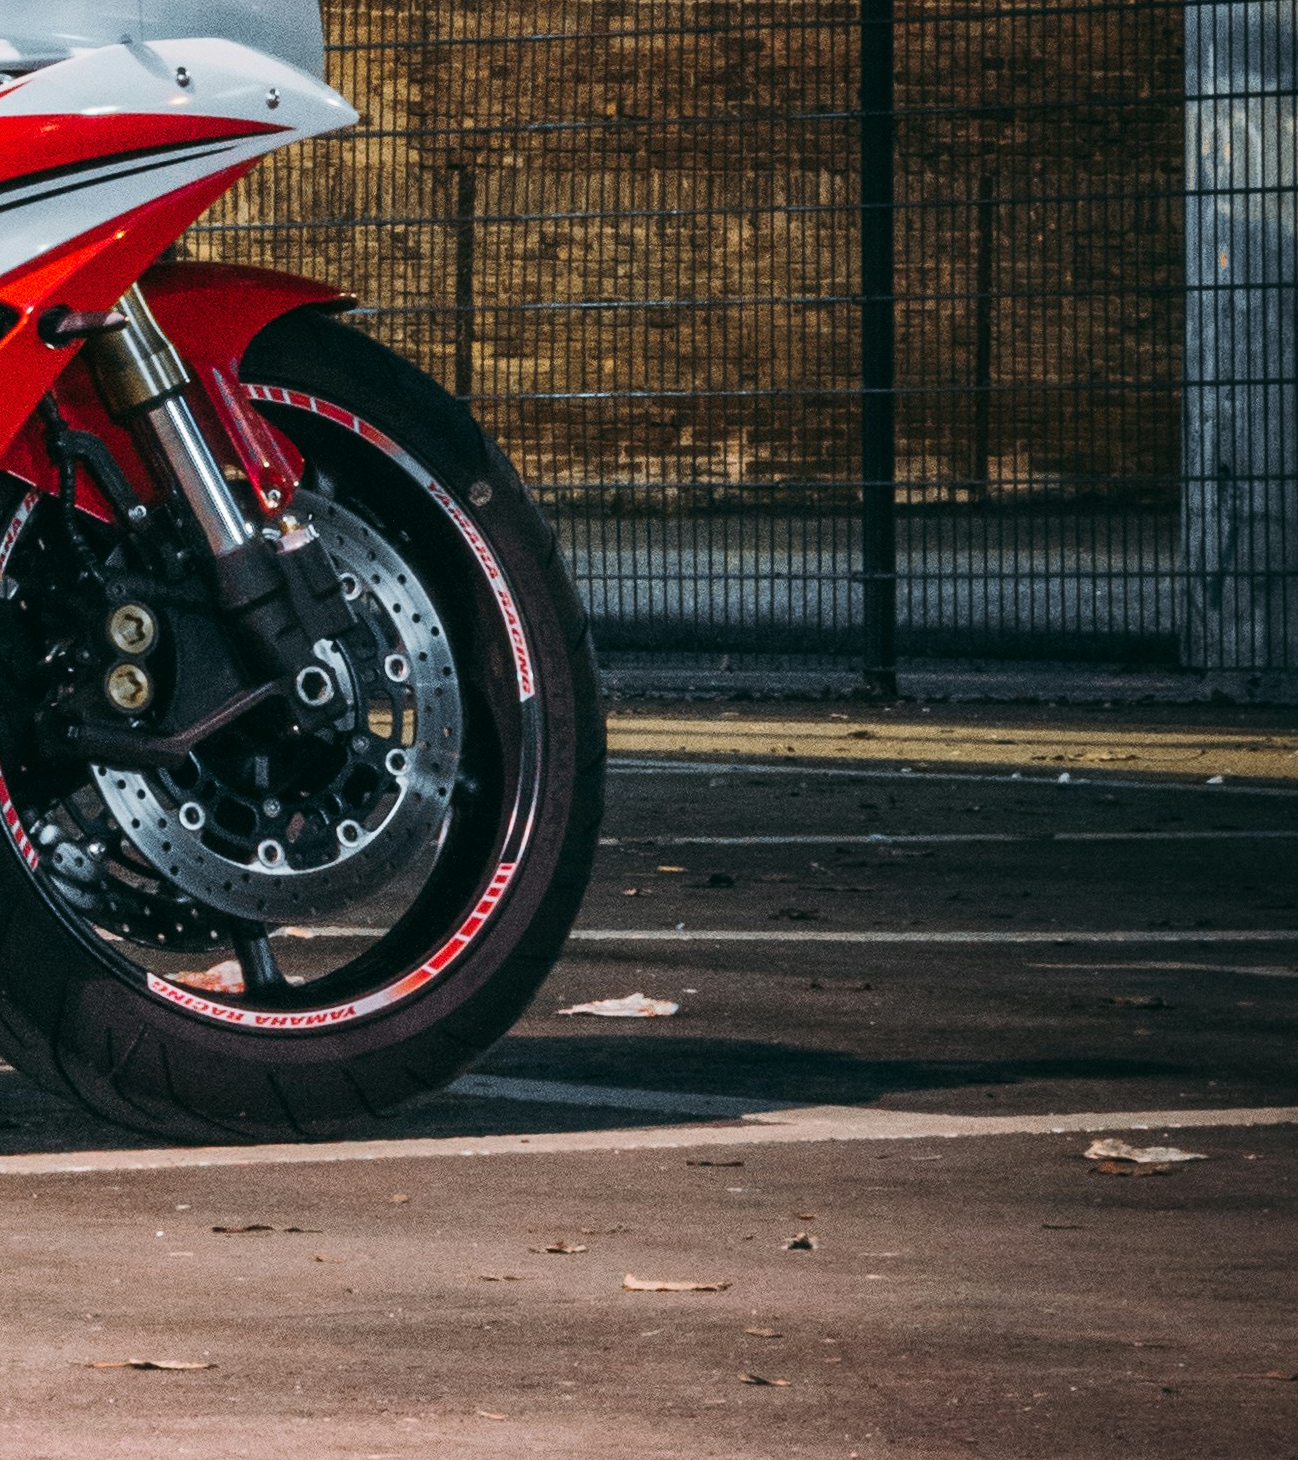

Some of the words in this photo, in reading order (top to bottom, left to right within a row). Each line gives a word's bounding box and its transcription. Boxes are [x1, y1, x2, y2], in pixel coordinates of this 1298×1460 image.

[428, 480, 499, 580] YAMAHA
[497, 590, 532, 694] RACING
[152, 981, 245, 1022] RACING
[255, 1005, 358, 1027] YAMAHA
